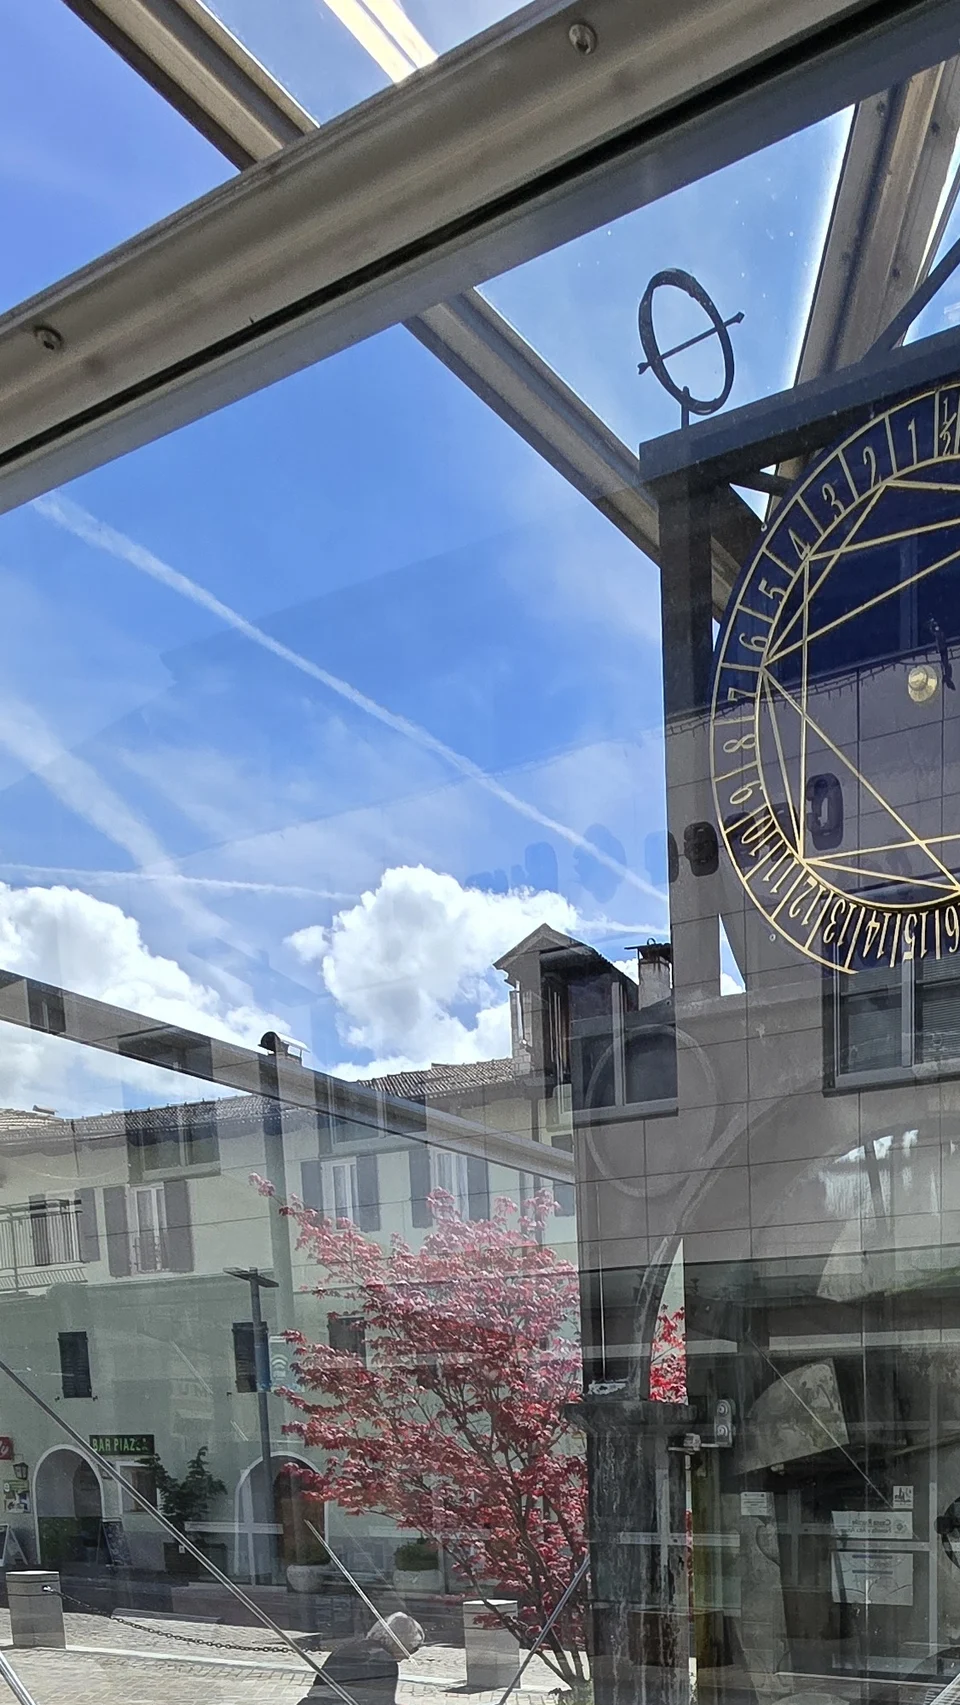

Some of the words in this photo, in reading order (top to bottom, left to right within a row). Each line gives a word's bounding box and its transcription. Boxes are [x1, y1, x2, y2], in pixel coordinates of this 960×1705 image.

[907, 417, 918, 465] 1
[863, 446, 883, 486] 2
[822, 483, 847, 521] 3
[788, 528, 812, 560] 4
[757, 577, 787, 605] 5
[738, 633, 769, 653] 6
[727, 687, 759, 701] 7
[723, 733, 756, 753] 8
[729, 779, 765, 804] 9
[741, 814, 781, 856] 10
[762, 849, 800, 893] 11
[789, 875, 827, 926] 12
[822, 898, 858, 947] 13
[862, 909, 893, 960] 14
[903, 910, 930, 960] 15
[92, 1438, 111, 1452] BAR
[114, 1437, 148, 1452] PIAZ
